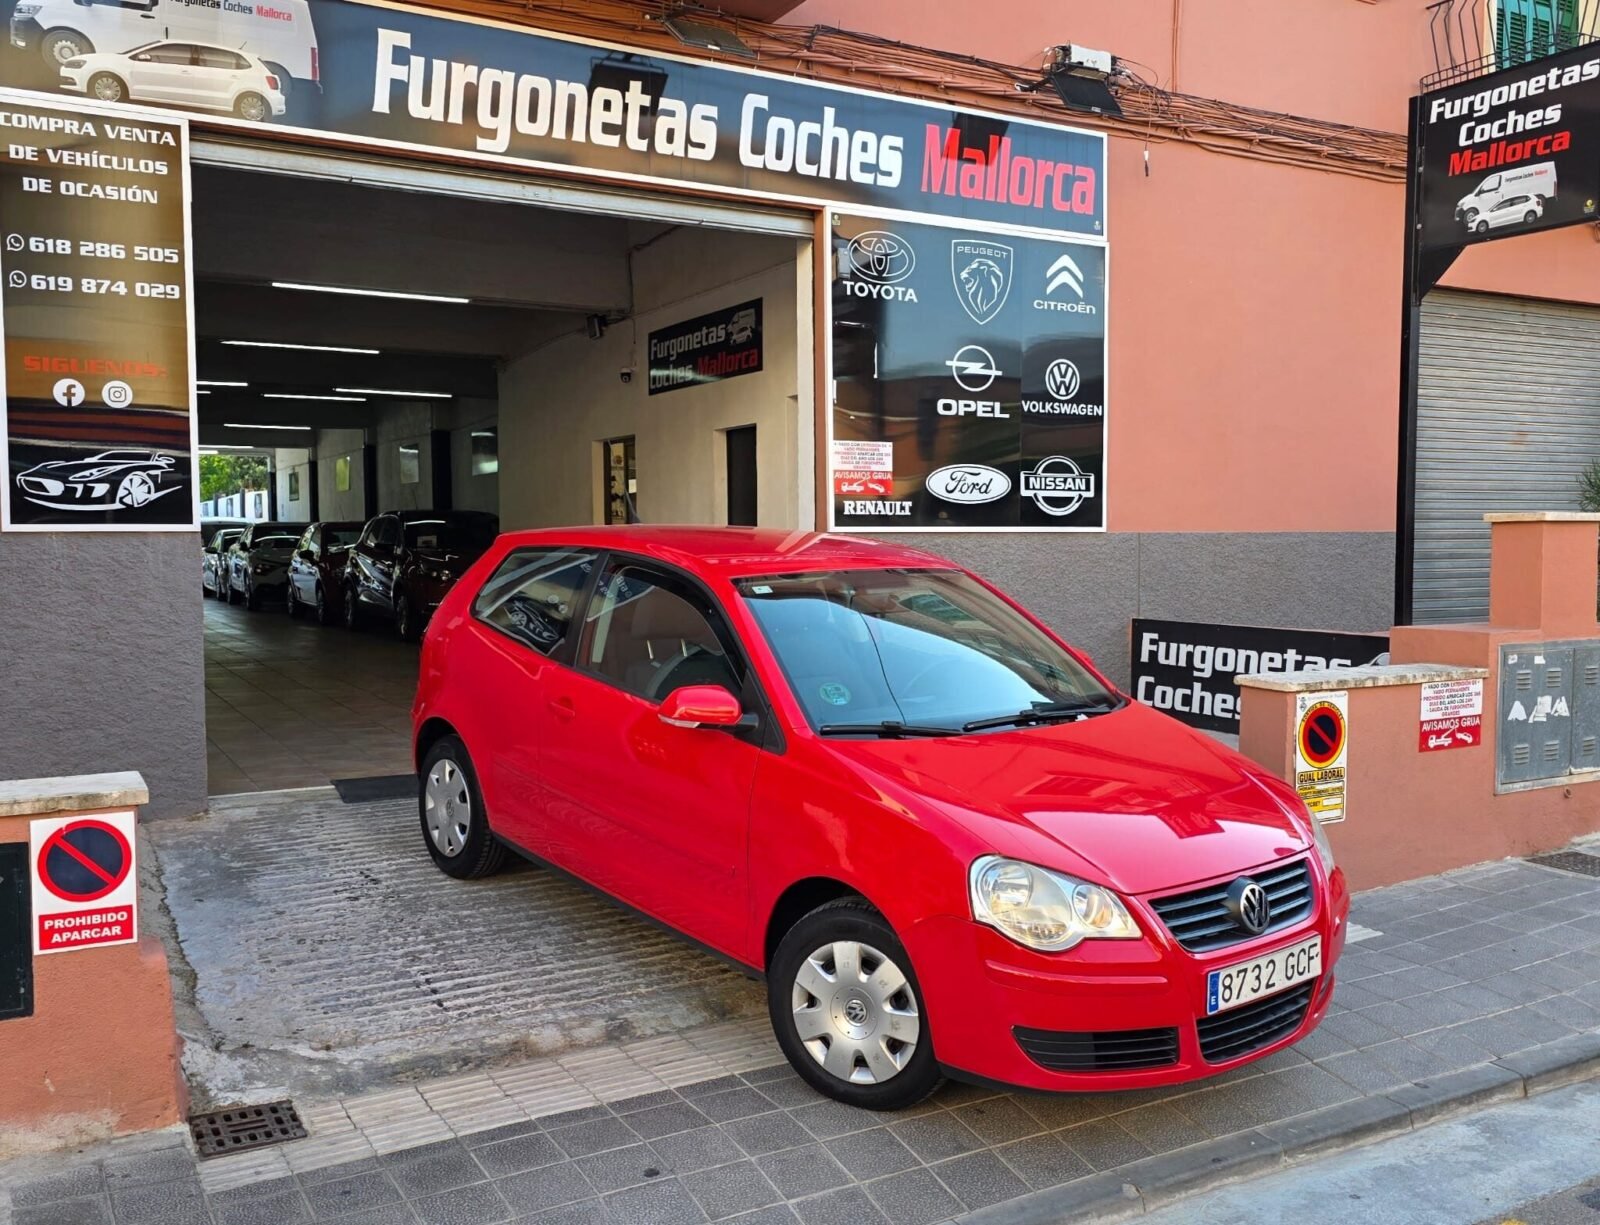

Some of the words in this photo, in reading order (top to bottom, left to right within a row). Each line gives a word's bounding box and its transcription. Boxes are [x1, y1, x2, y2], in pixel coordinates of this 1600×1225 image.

[223, 0, 253, 15] Coches
[256, 5, 292, 22] Mallorca
[1429, 58, 1600, 124] Furgonetas
[0, 111, 97, 137] COMPRA
[105, 123, 177, 147] VENTA
[372, 27, 718, 162] Furgonetas
[739, 93, 904, 189] Coches
[921, 123, 1096, 216] Mallorca
[1458, 103, 1562, 147] Coches
[9, 144, 39, 161] DE
[46, 147, 168, 175] VEHÍCULOS
[1448, 130, 1571, 177] Mallorca
[22, 176, 52, 194] DE
[59, 179, 159, 204] OCASIÓN
[28, 236, 72, 255] 618
[79, 240, 126, 260] 286
[134, 246, 179, 264] 505
[957, 245, 1008, 259] PEUGEOT
[30, 274, 73, 293] 619
[81, 278, 128, 297] 874
[134, 281, 180, 300] 029
[843, 281, 918, 303] TOYOTA
[650, 323, 727, 361] Furgonetas
[697, 348, 758, 376] Mallorca
[936, 398, 1010, 419] OPEL
[1021, 400, 1103, 416] VOLKSWAGEN
[834, 472, 871, 480] AVISAMOS
[944, 470, 993, 495] Ford
[1029, 476, 1086, 491] NISSAN
[843, 500, 912, 516] RENAULT
[1137, 675, 1241, 720] Coche
[1422, 718, 1460, 732] AVISAMOS
[1461, 716, 1480, 727] GRUA
[1316, 769, 1344, 780] LABORAL
[44, 911, 128, 930] PROHIBIDO
[51, 926, 122, 943] APARCAR
[1221, 959, 1277, 1003] 8732
[1284, 943, 1318, 981] GCF
